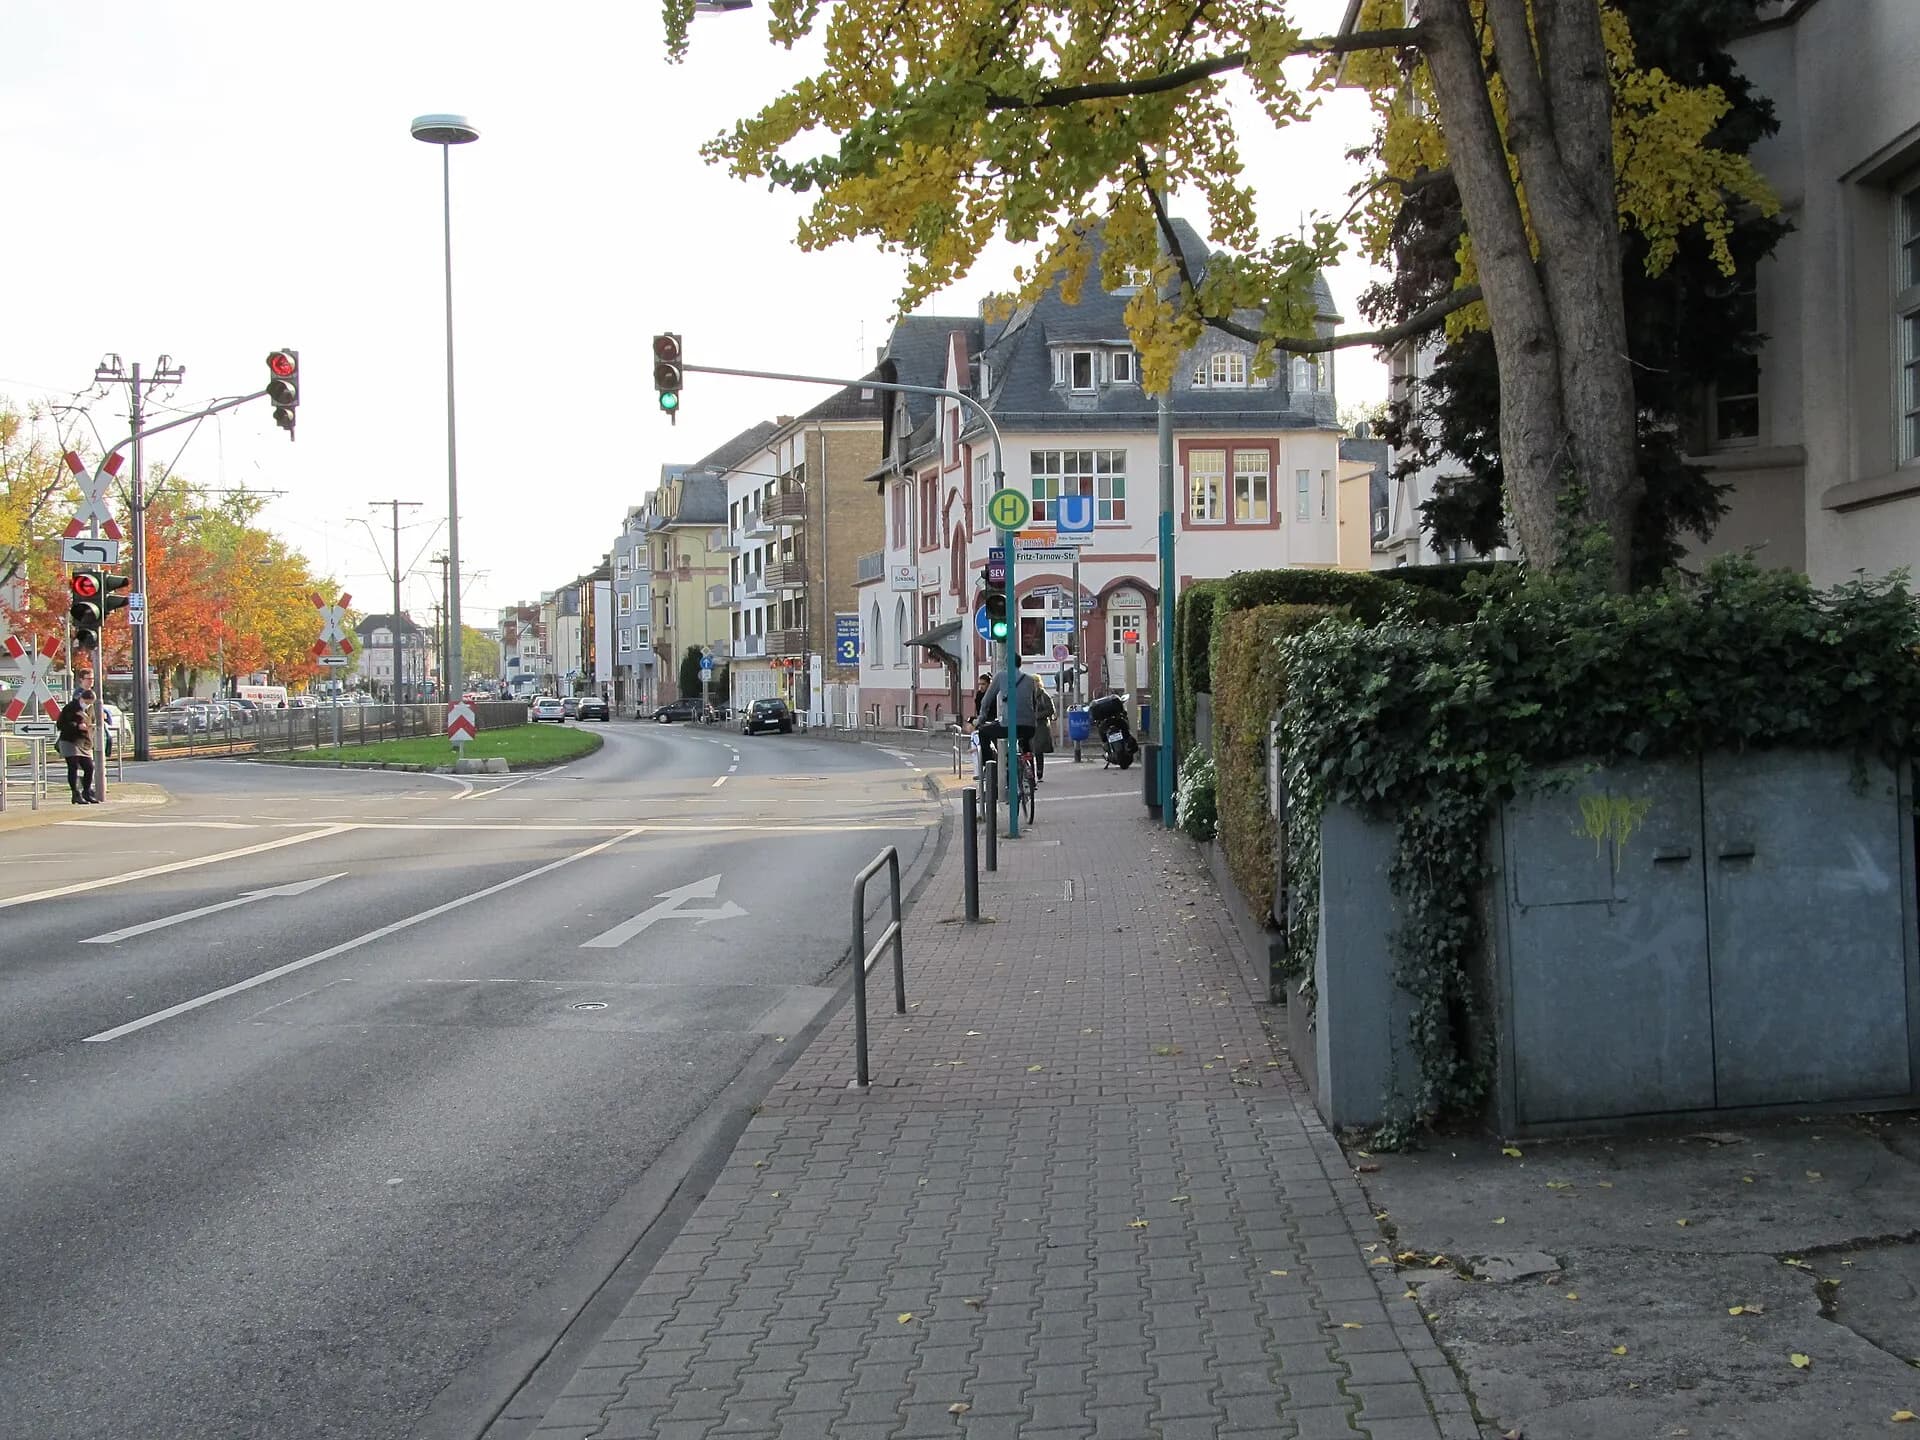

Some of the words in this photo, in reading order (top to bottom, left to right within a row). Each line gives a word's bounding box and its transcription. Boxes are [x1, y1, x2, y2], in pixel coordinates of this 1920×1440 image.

[1001, 498, 1017, 521] H
[1059, 498, 1091, 530] U
[1016, 552, 1076, 561] Fritz-Tarnow-Str.
[990, 569, 1005, 577] SEV
